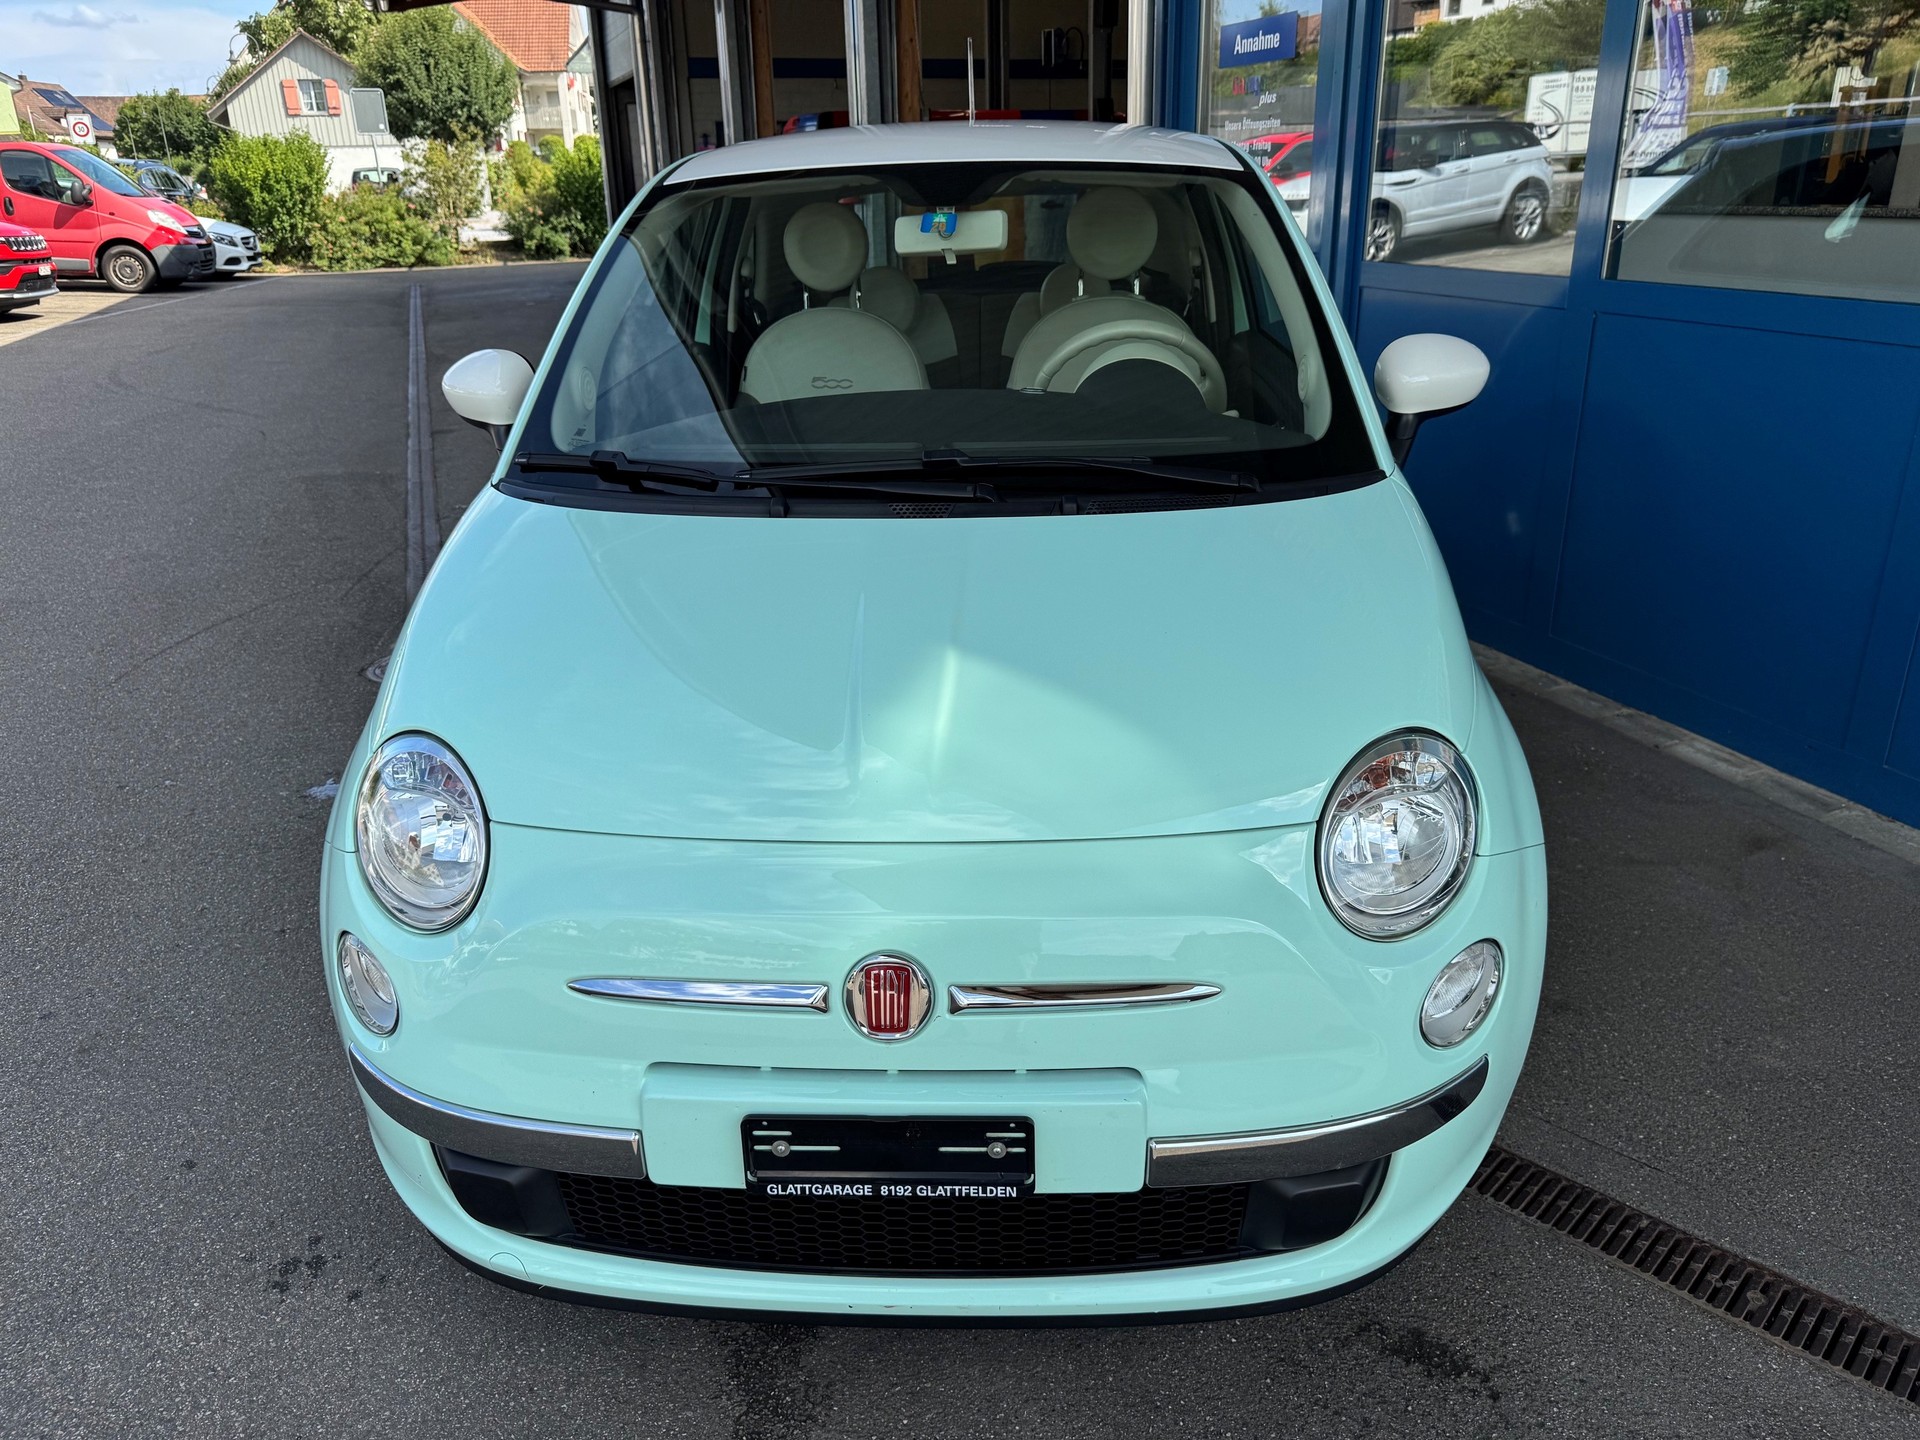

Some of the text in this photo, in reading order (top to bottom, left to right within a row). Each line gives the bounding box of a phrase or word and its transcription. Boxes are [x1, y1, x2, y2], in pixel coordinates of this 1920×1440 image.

[1233, 30, 1280, 55] Annahme
[1259, 91, 1277, 107] plus
[1225, 117, 1281, 131] Unsere Öffnungszeiten
[811, 376, 854, 389] 500
[870, 969, 908, 1029] FIAT
[766, 1184, 1017, 1198] GLATTGARAGE 8192 GLATTFELDEN
